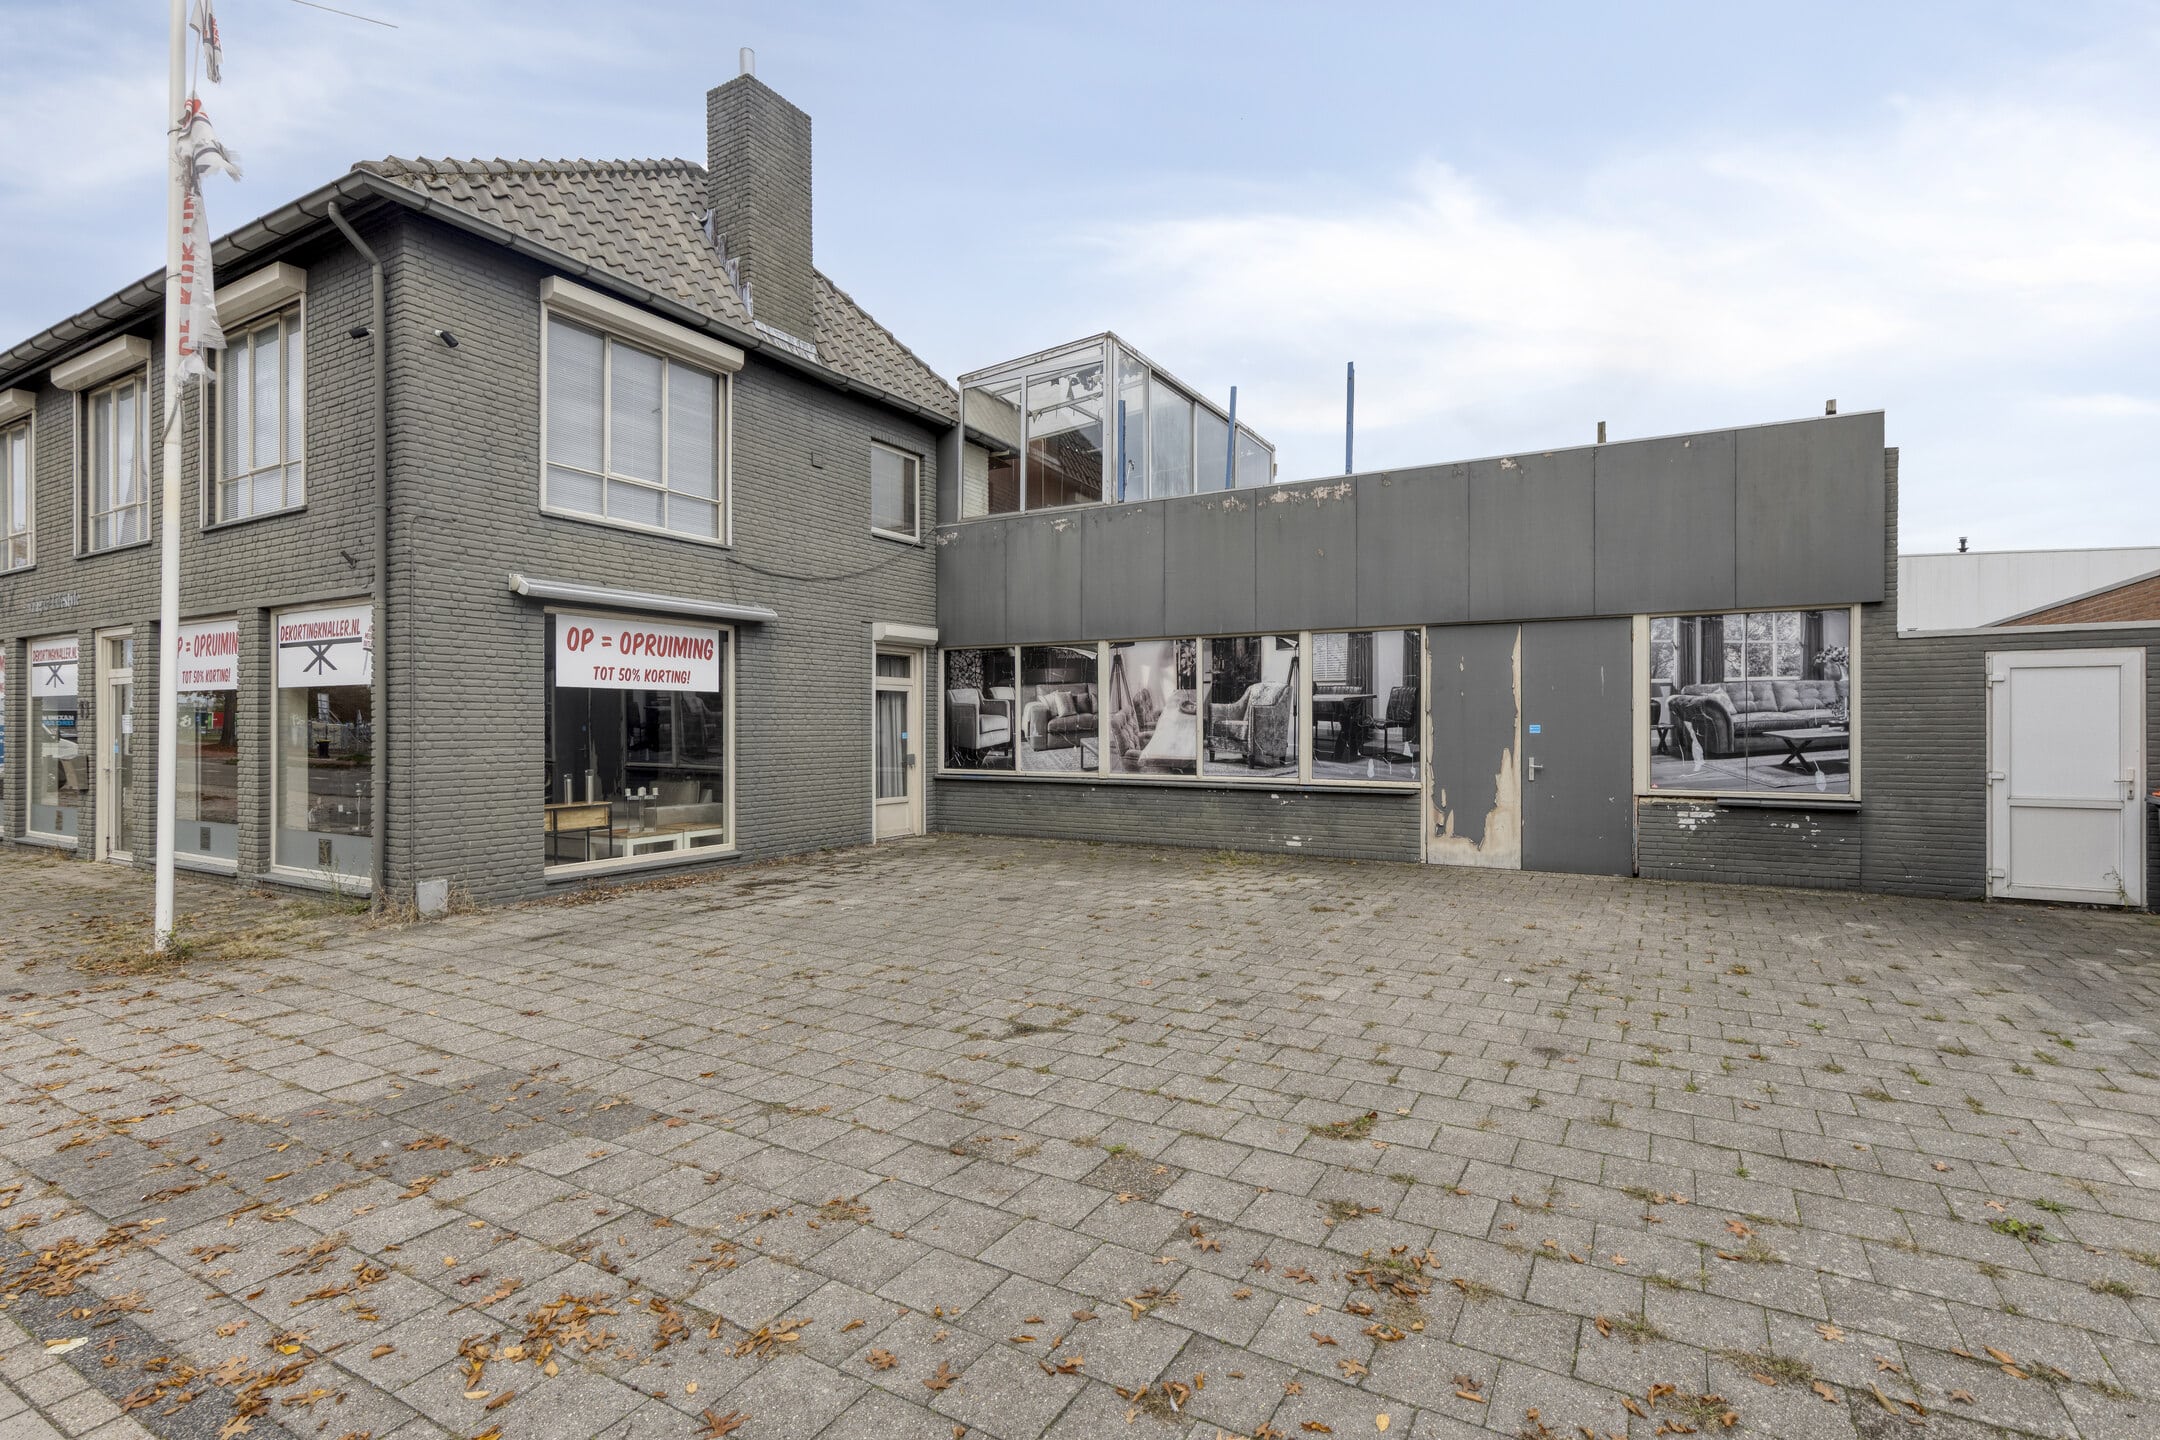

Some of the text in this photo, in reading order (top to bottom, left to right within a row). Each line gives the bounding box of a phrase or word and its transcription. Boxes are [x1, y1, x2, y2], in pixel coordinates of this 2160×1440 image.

[280, 618, 361, 641] DEKORTINGKNALLER.NL
[185, 641, 191, 652] =
[194, 631, 239, 658] OPRUIMIN
[566, 626, 714, 661] OP = OPRUIMING
[182, 667, 231, 684] TOT 50% KORTING!
[593, 666, 691, 684] TOT 50% KORTING!
